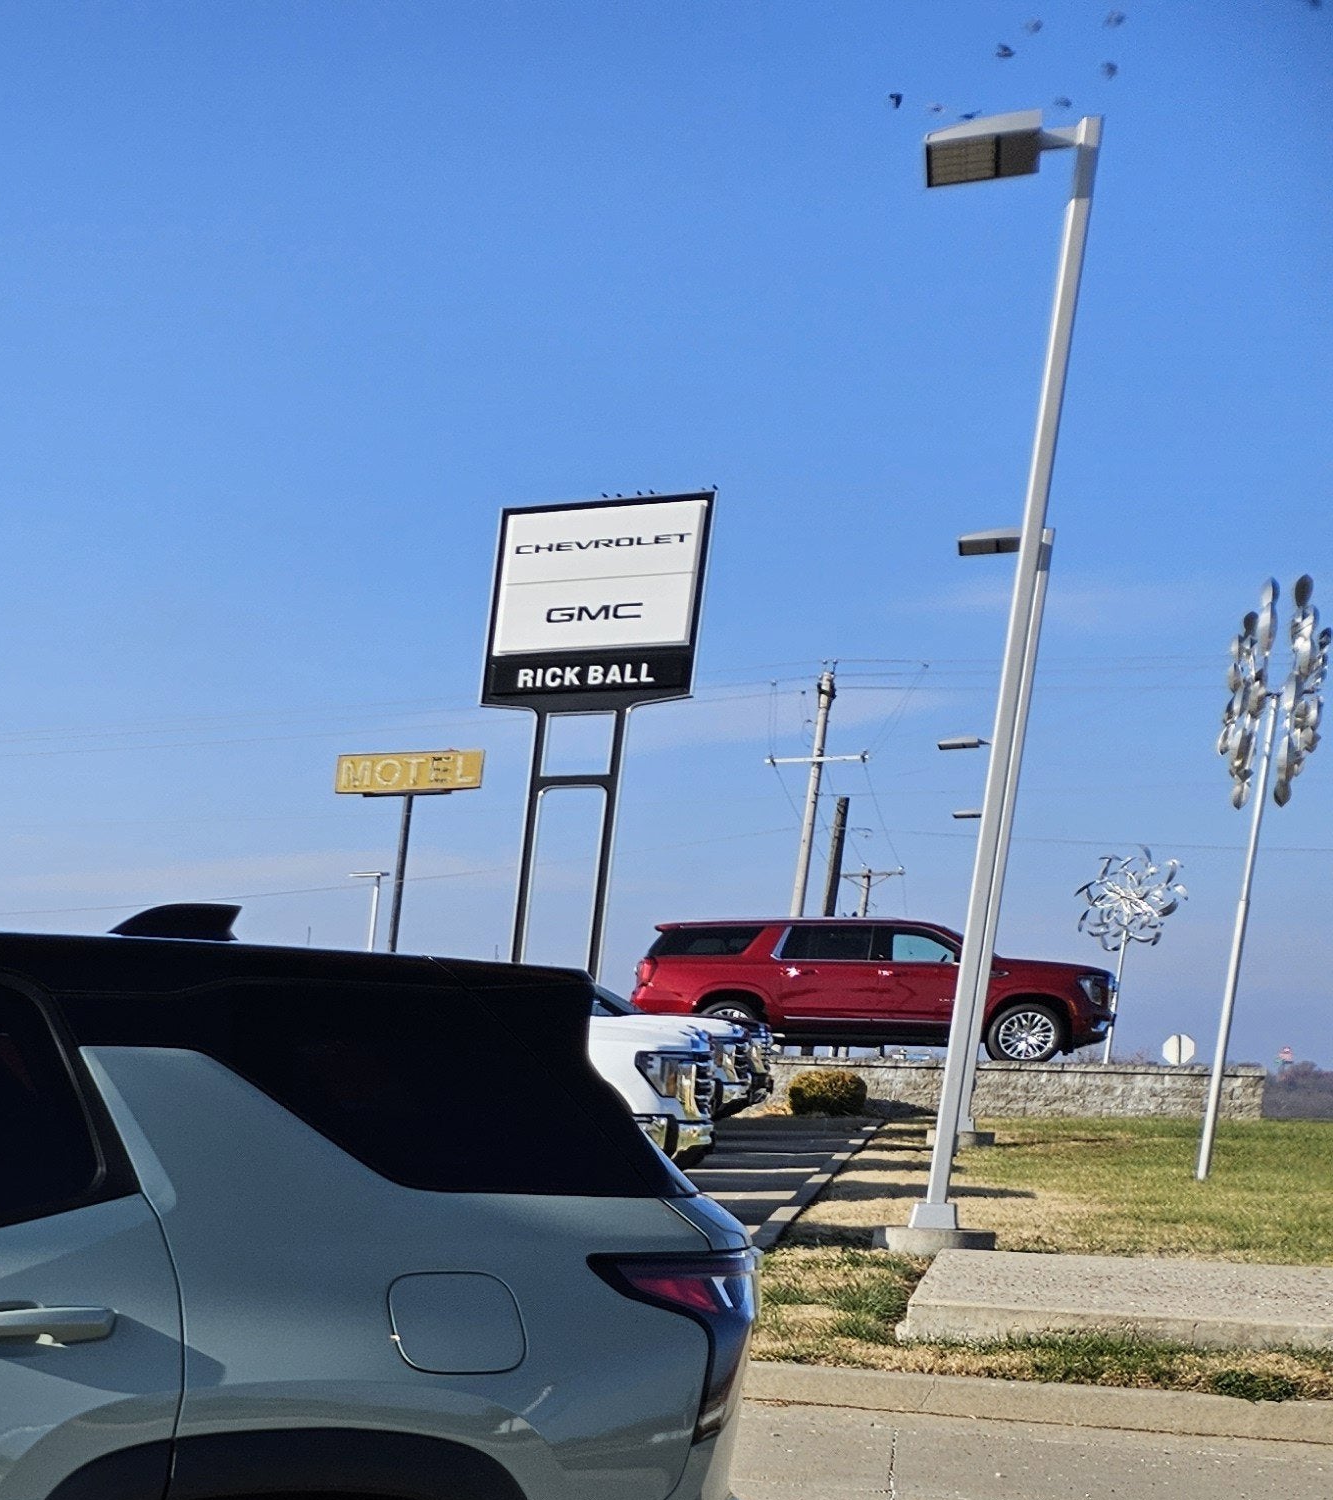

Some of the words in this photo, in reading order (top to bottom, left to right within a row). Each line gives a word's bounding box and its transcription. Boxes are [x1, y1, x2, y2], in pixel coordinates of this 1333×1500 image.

[515, 532, 692, 555] CHEVROLET
[546, 602, 643, 623] GMC
[517, 666, 581, 688] RICK
[587, 663, 655, 685] BALL
[341, 754, 476, 788] MOTEL
